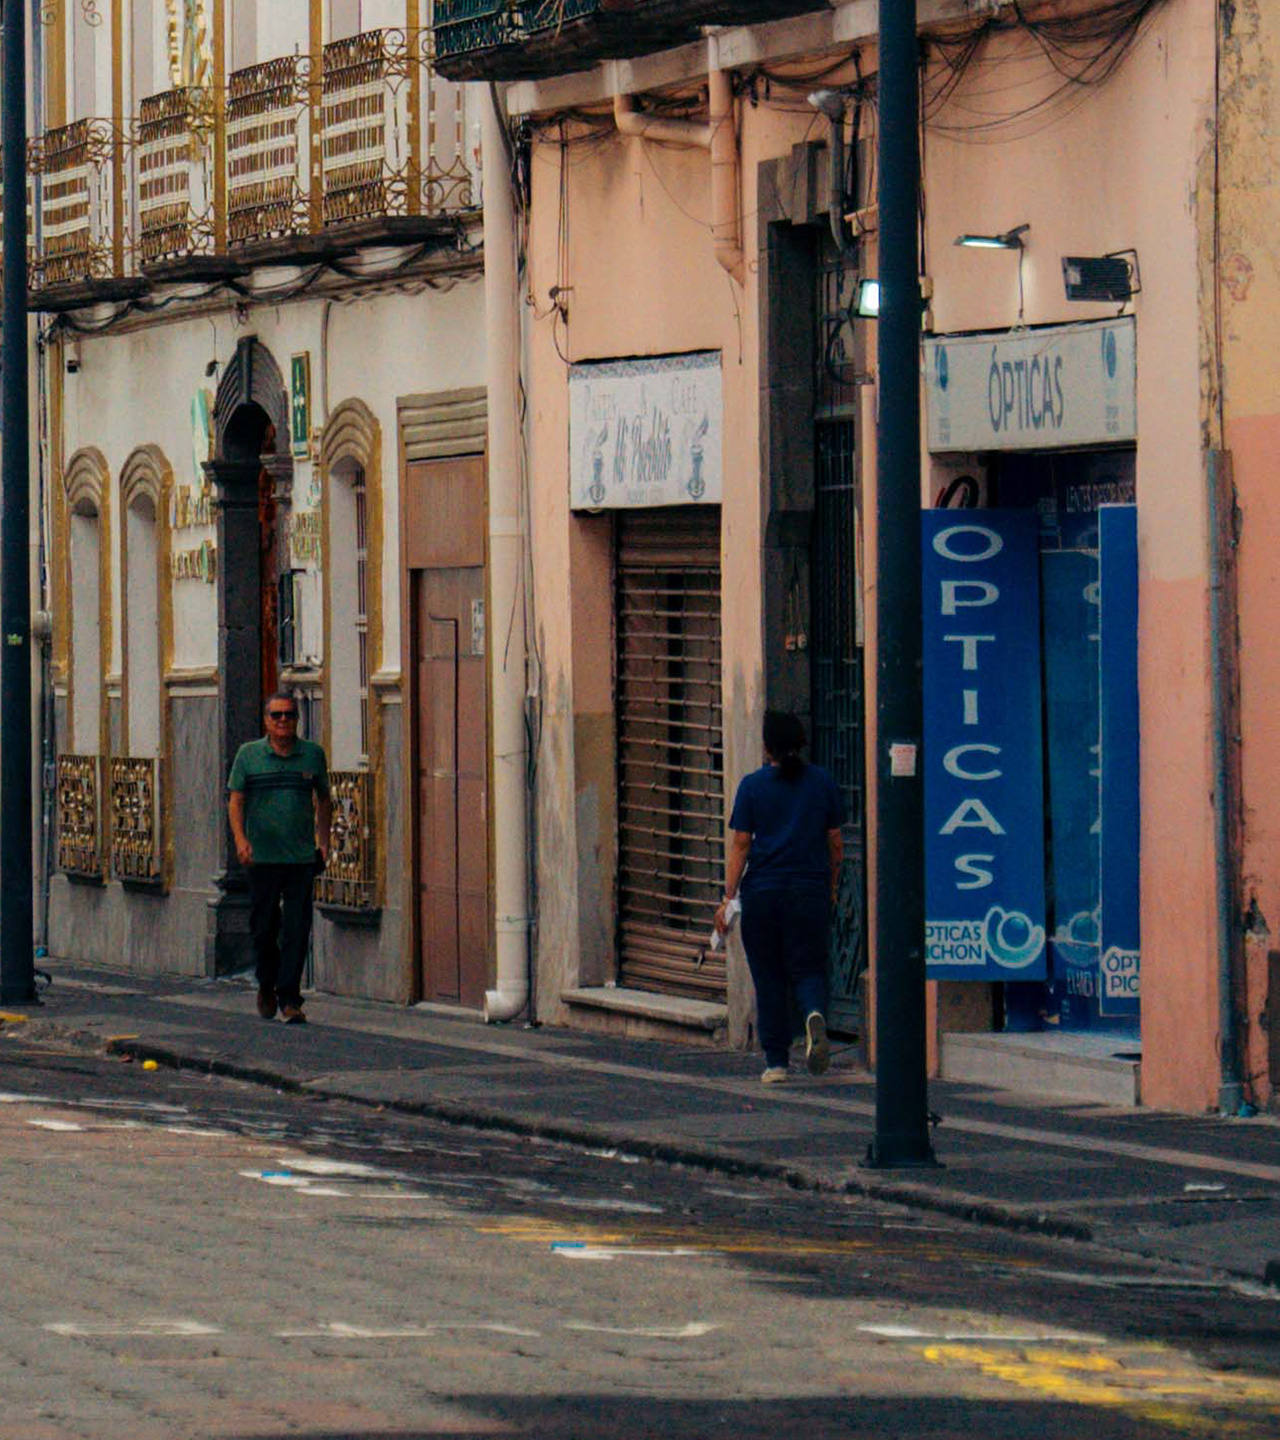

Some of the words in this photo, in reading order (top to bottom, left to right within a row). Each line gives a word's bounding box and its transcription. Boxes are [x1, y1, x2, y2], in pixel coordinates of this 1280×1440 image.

[989, 334, 1064, 433] ÓPTICAS
[933, 525, 1007, 890] OPTICAS
[925, 926, 982, 942] PTICAS
[926, 944, 982, 960] ICHON
